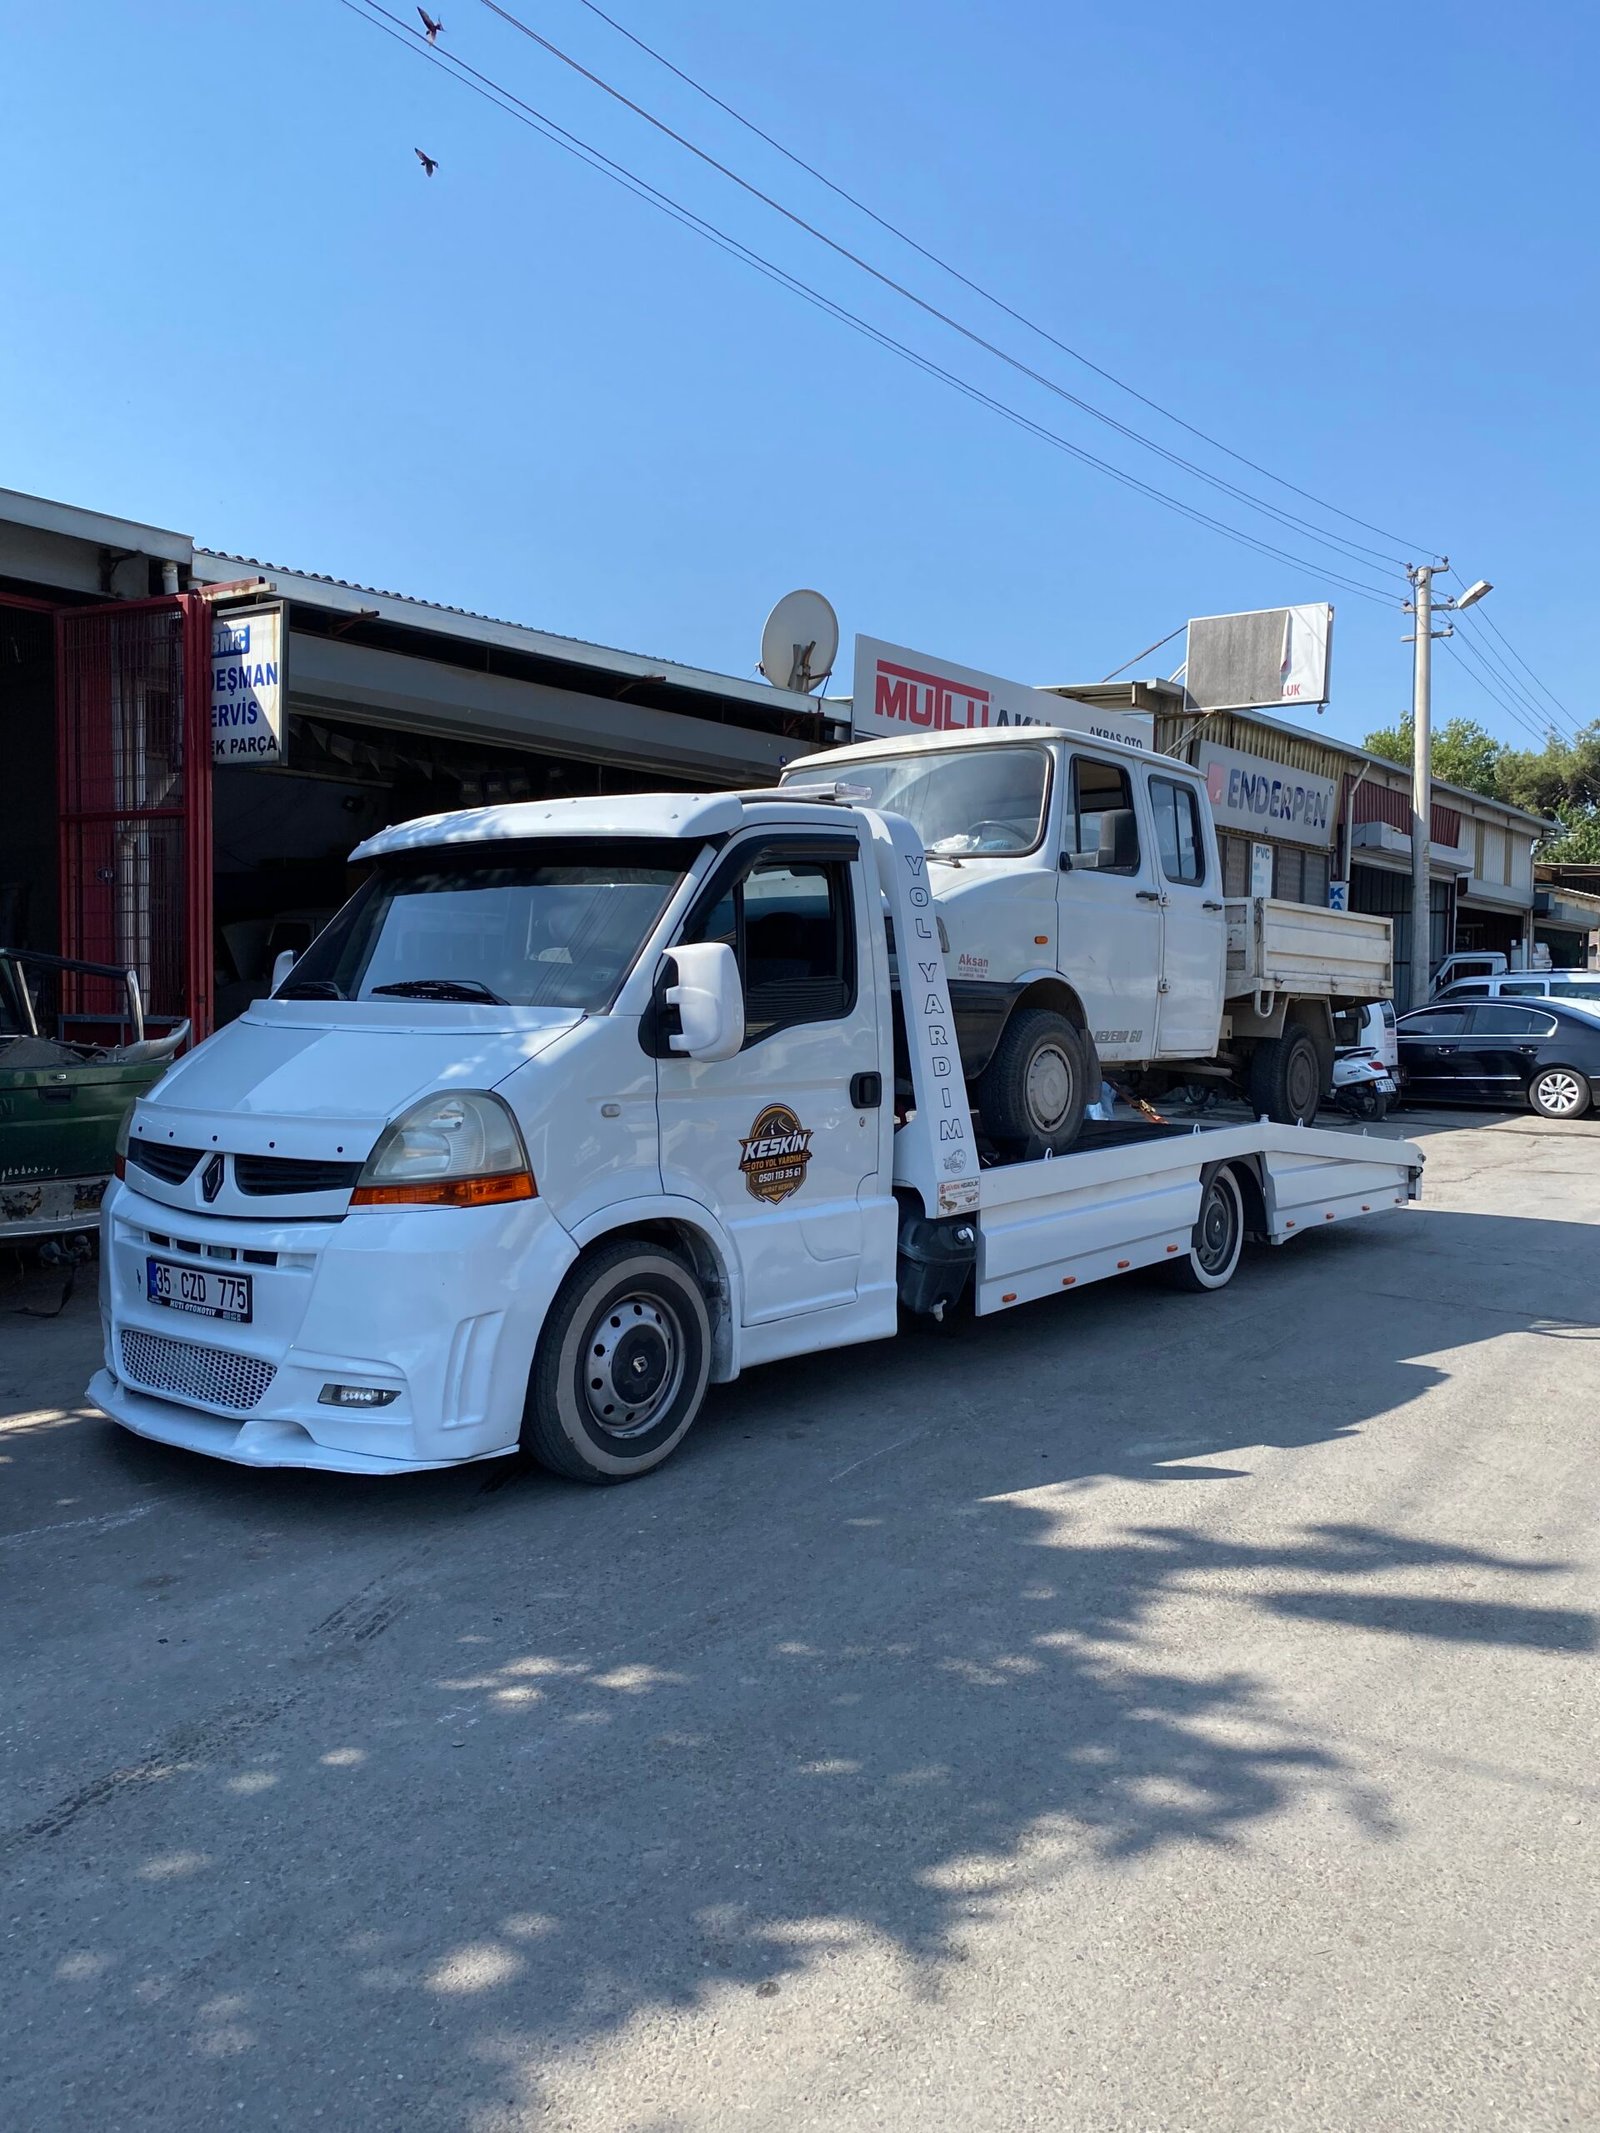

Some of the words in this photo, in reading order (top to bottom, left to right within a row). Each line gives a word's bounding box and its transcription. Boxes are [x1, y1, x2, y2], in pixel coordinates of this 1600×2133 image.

[211, 662, 278, 697] EŞMAN
[875, 659, 990, 730] MUTLU
[230, 735, 278, 756] PARÇA
[1227, 769, 1329, 829] ENDERPEN
[1255, 845, 1271, 861] PVC
[958, 953, 989, 968] Aksan
[904, 854, 932, 939] YOL
[918, 961, 964, 1142] YARDIM
[750, 1161, 764, 1169] OTO
[765, 1158, 777, 1168] YOL
[156, 1266, 171, 1295] 35
[181, 1271, 207, 1303] CZD
[218, 1278, 246, 1310] 775
